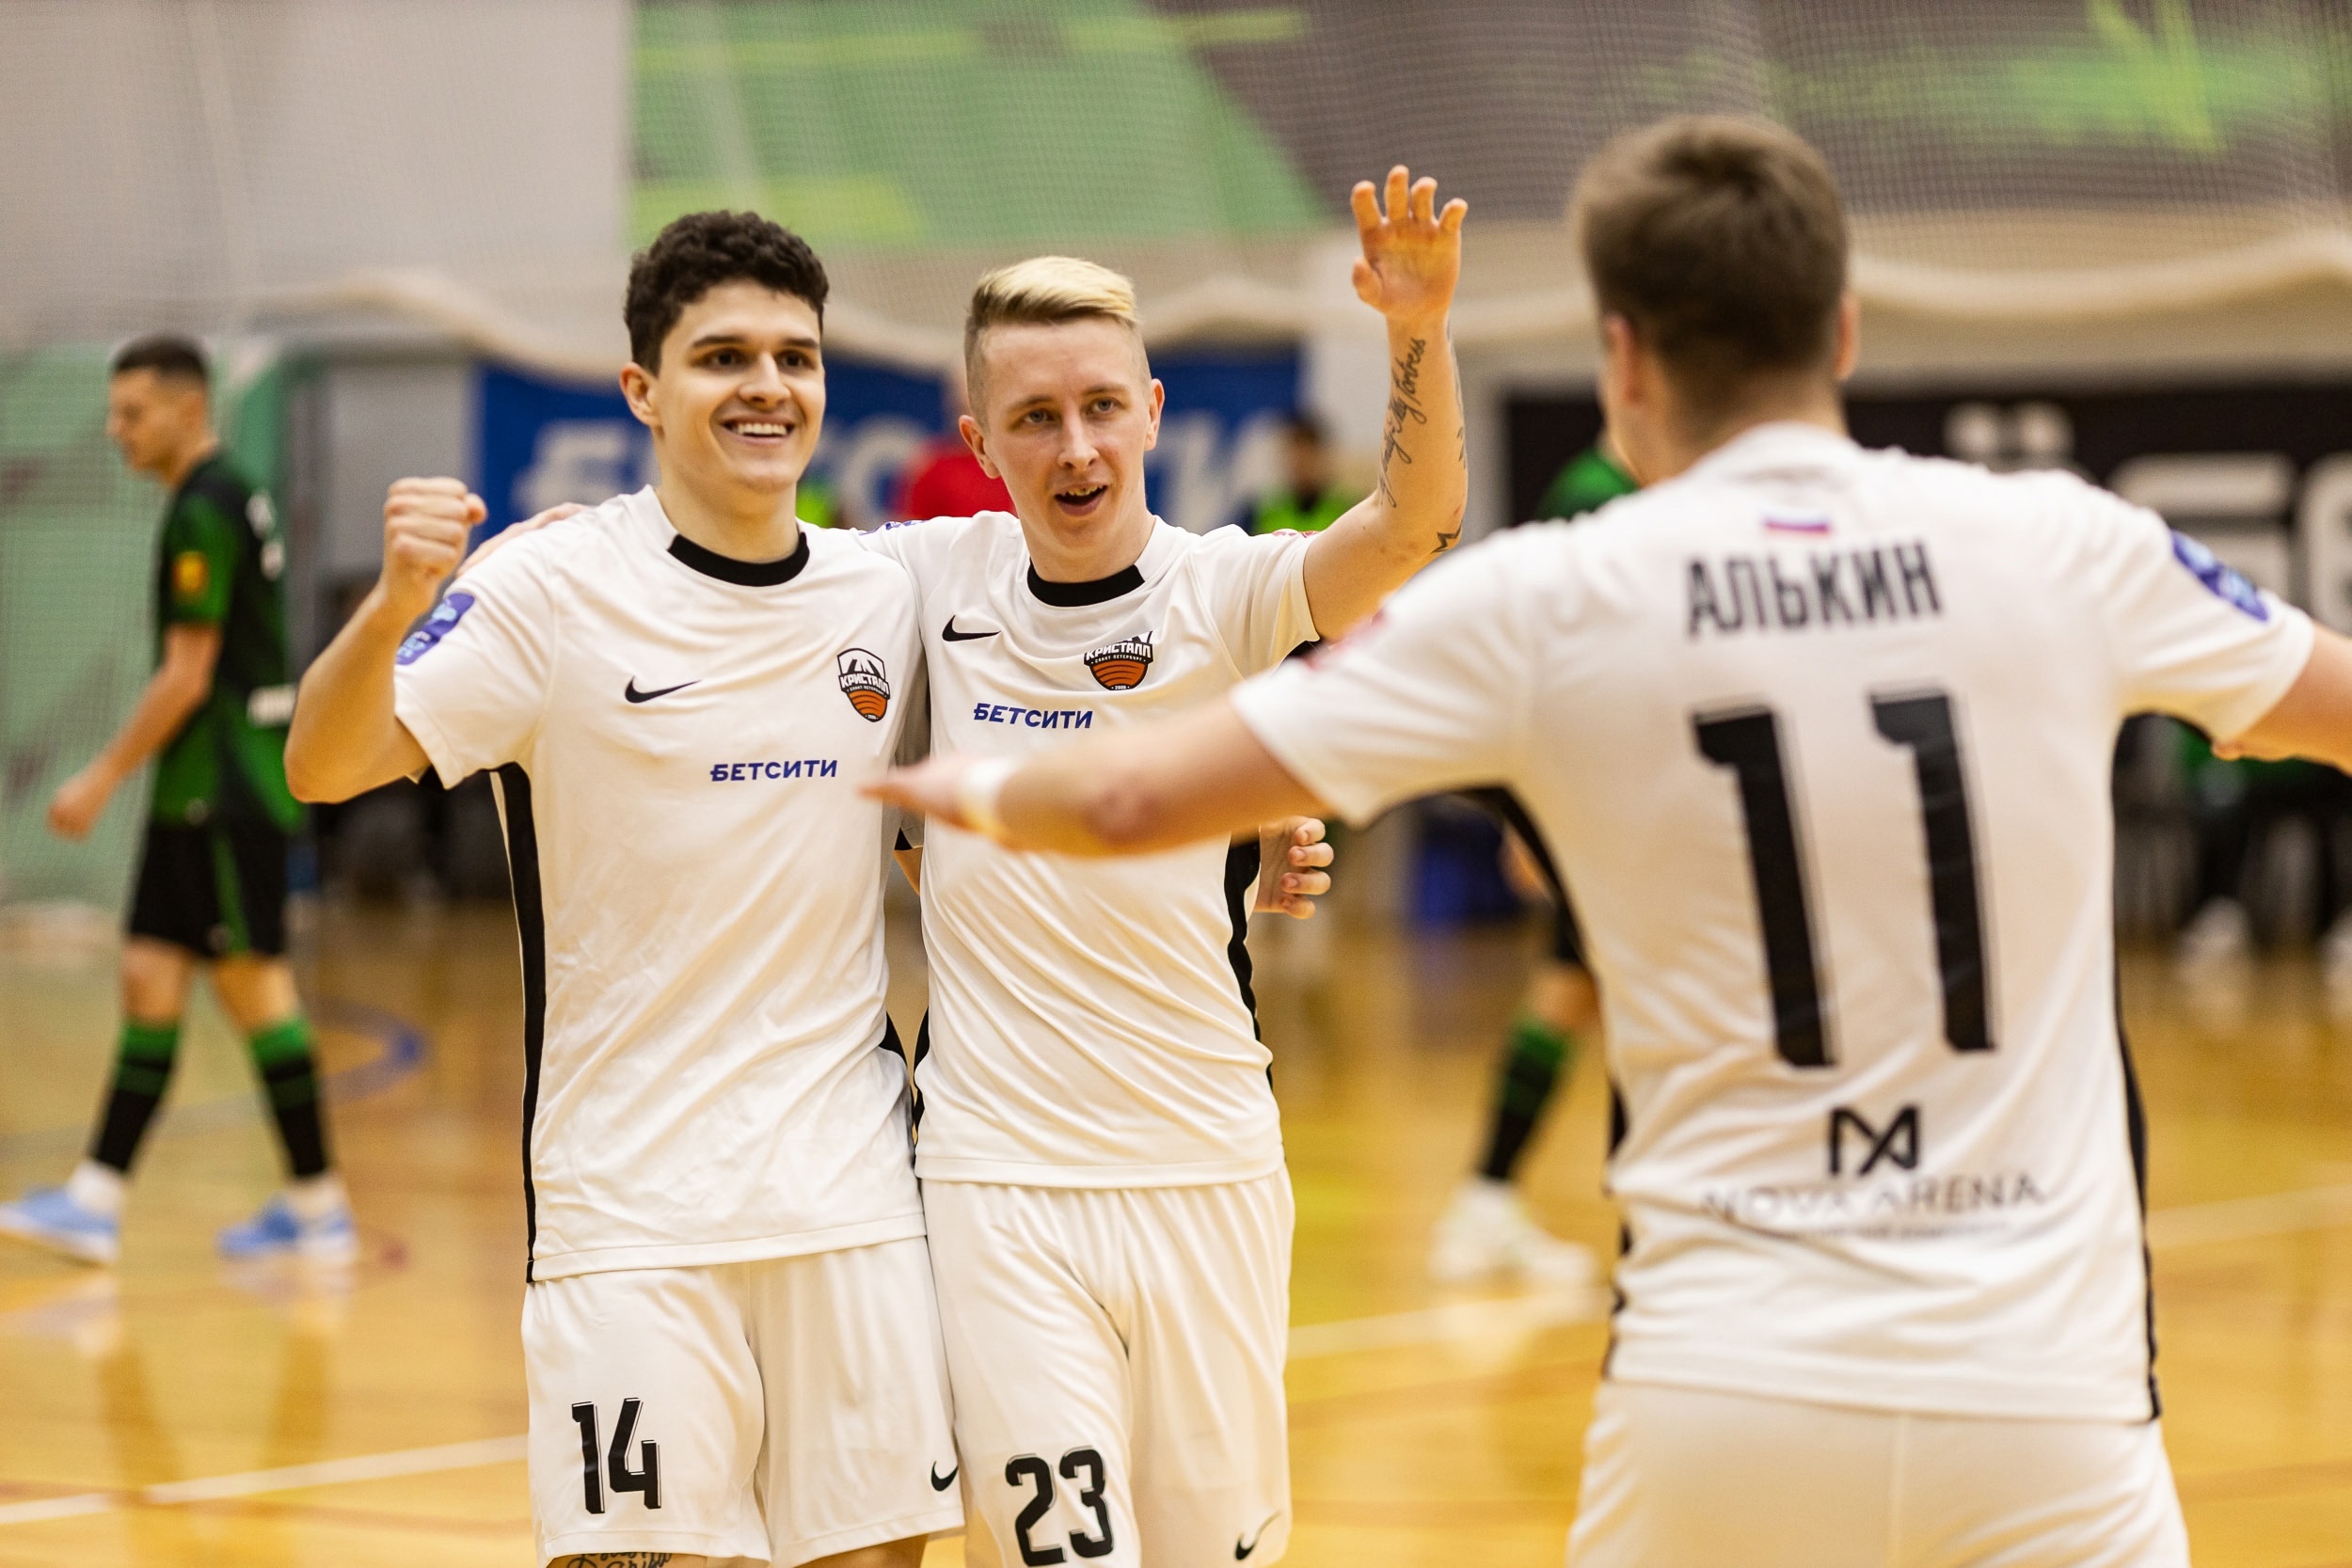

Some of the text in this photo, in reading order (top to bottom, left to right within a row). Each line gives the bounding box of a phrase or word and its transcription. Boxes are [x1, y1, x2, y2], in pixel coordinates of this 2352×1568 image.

[1688, 539, 1942, 638] АЛЬКИН
[973, 703, 1093, 729] БЕТСИТИ
[710, 759, 838, 783] БЕТСИТИ
[1691, 690, 1998, 1067] 11
[1877, 1172, 2047, 1214] ARENA
[572, 1397, 662, 1514] 14
[1005, 1444, 1115, 1567] 23
